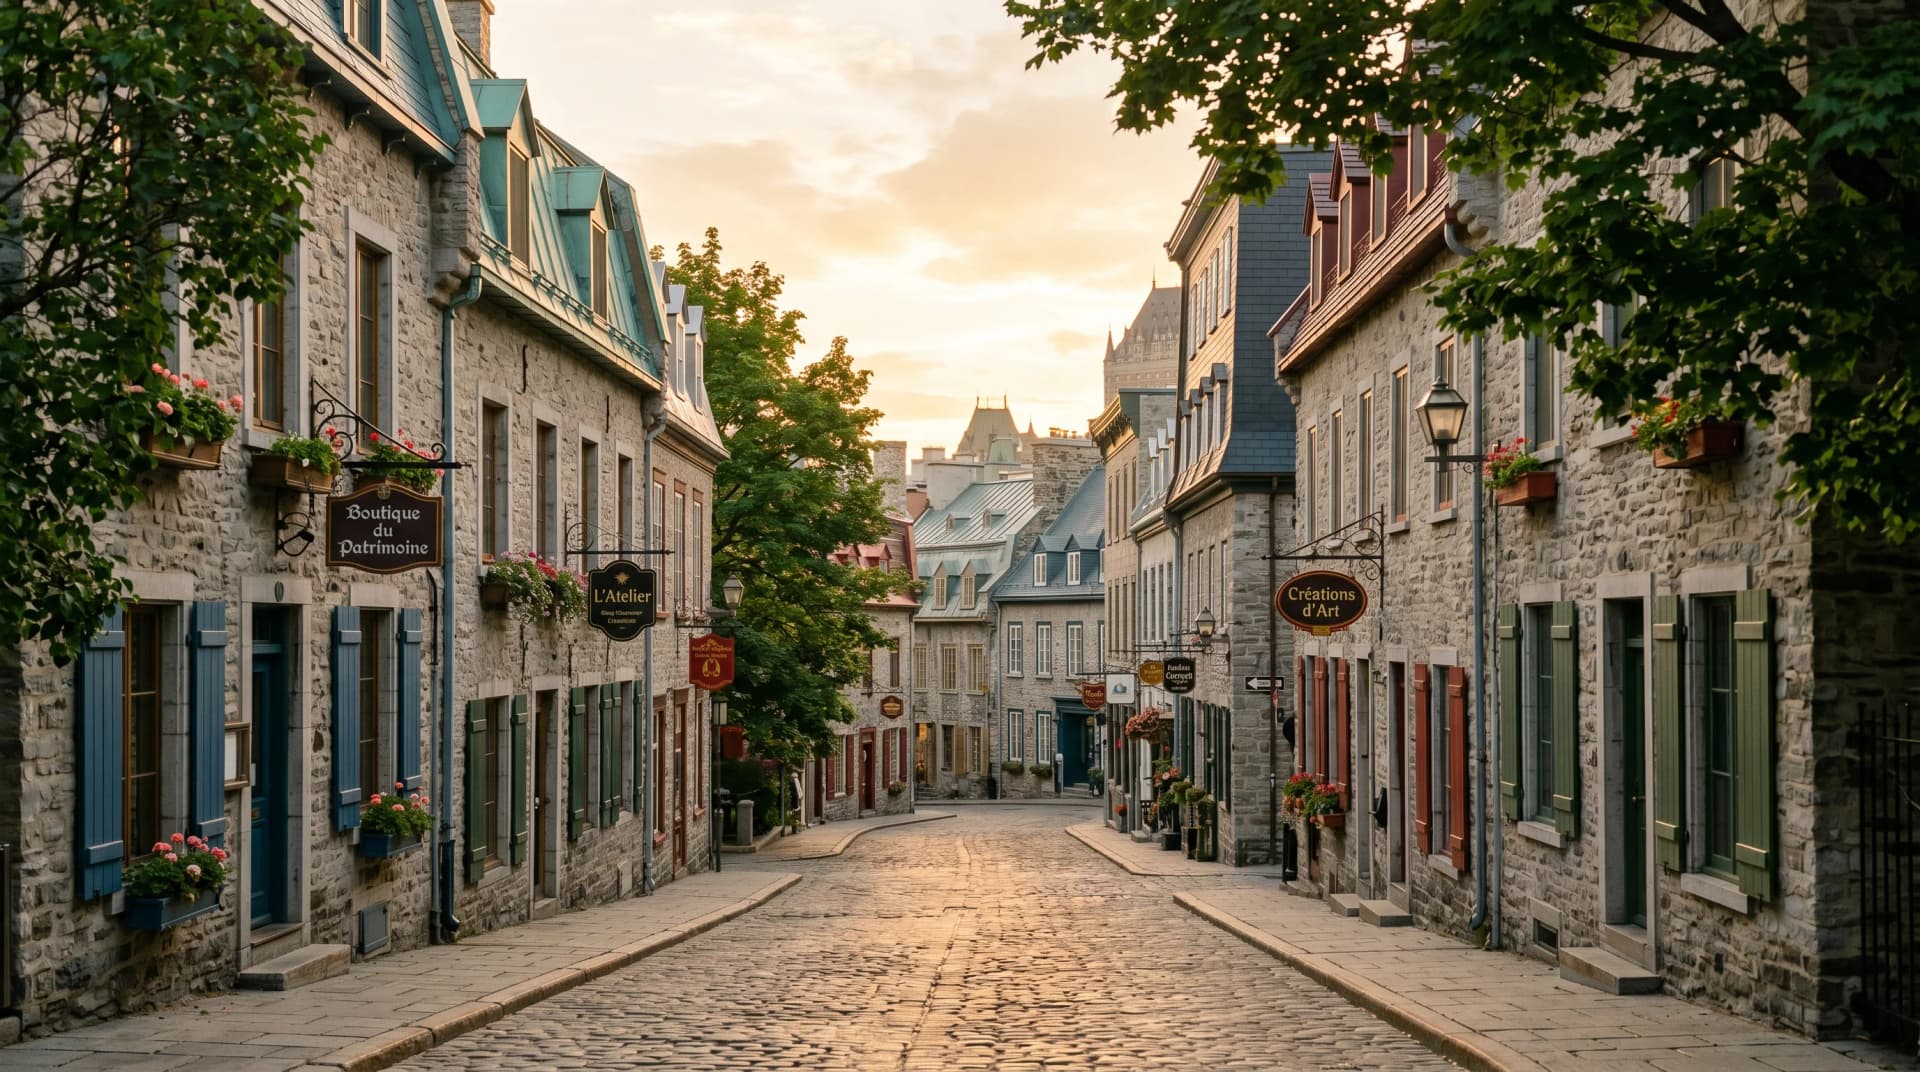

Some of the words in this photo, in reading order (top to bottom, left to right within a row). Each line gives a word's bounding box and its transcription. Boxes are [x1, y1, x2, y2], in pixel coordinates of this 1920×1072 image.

[345, 504, 421, 523] Boutique
[373, 522, 393, 537] du
[338, 539, 429, 558] Patrimoine
[594, 588, 652, 603] L'Atelier
[1288, 586, 1356, 601] Créations
[1302, 602, 1340, 617] d'Art
